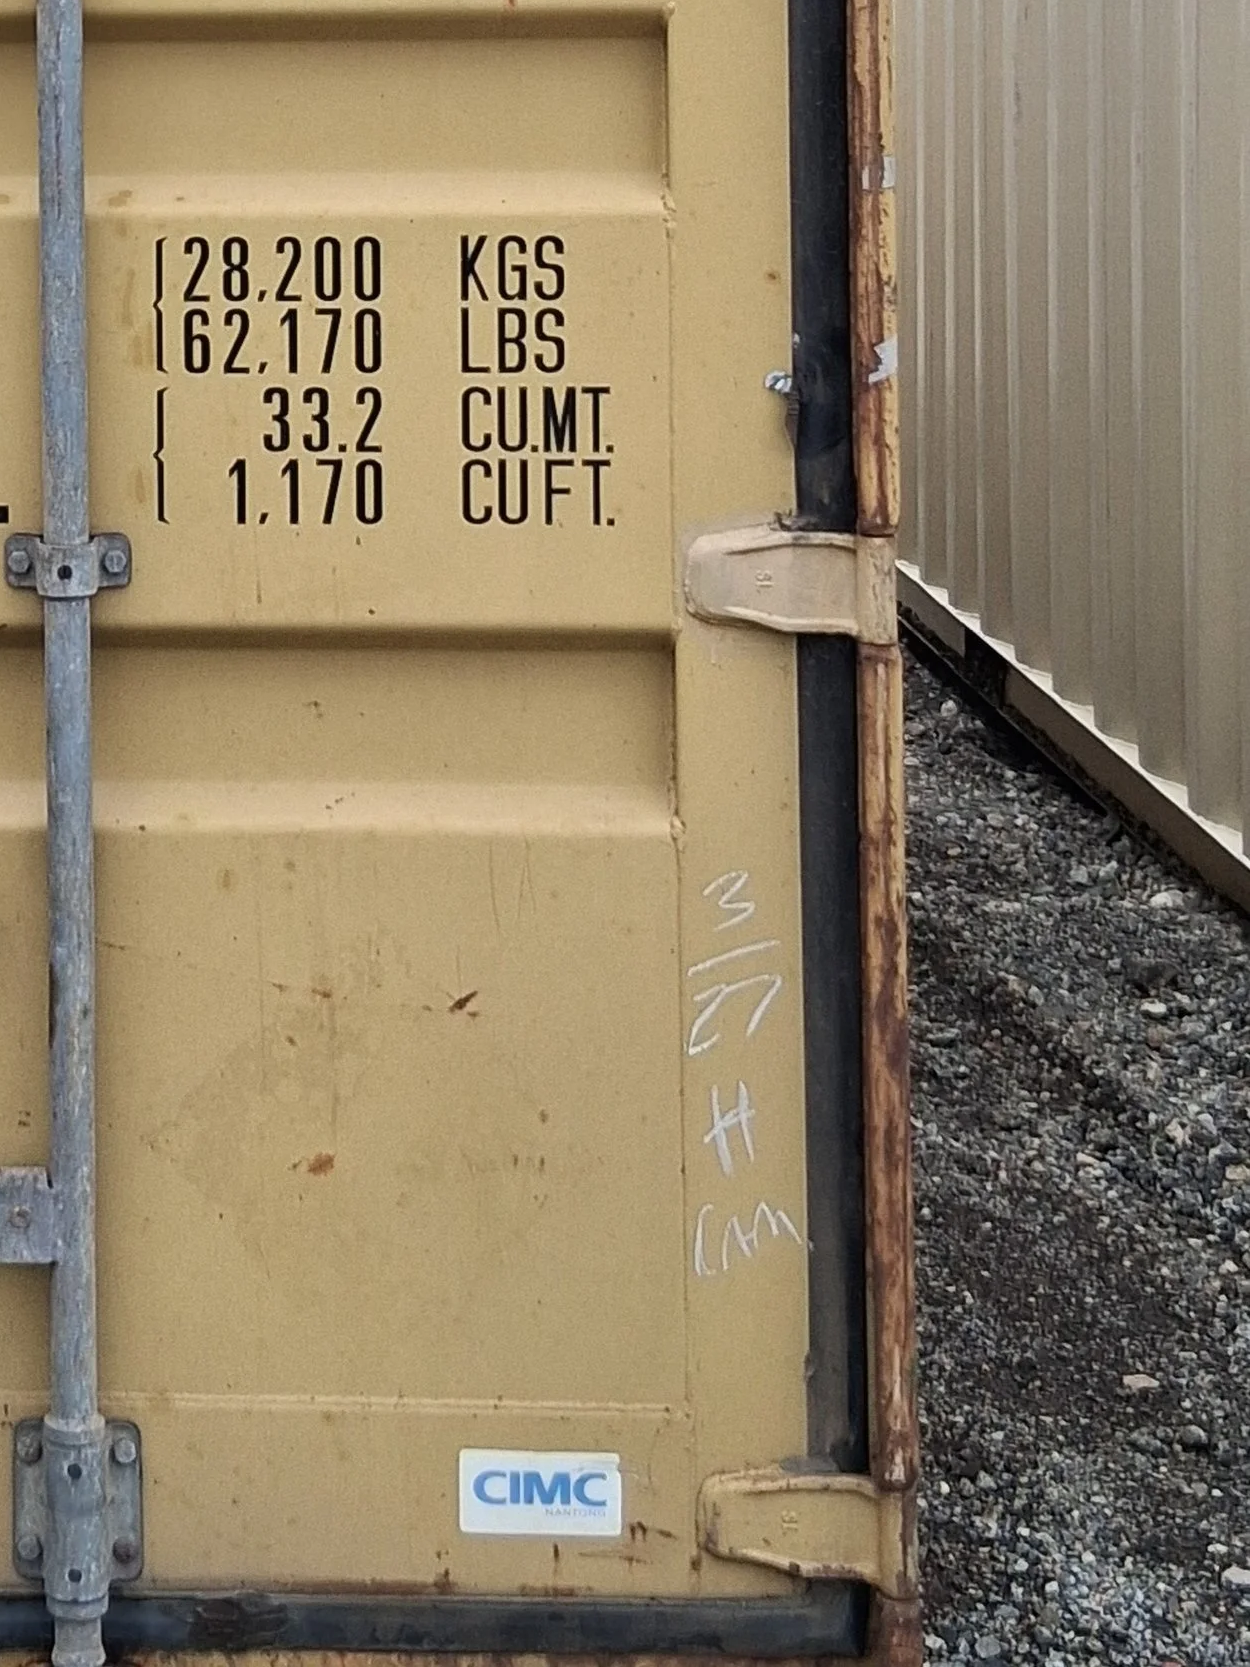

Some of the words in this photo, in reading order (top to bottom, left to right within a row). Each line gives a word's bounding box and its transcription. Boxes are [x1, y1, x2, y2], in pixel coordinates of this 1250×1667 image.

[183, 236, 381, 302] 28,200
[460, 235, 565, 301] KGS
[183, 308, 382, 374] 62,170
[460, 307, 565, 374] LBS
[263, 386, 382, 453] 33.2
[228, 458, 383, 525] 1,170
[472, 1469, 608, 1507] CIMC
